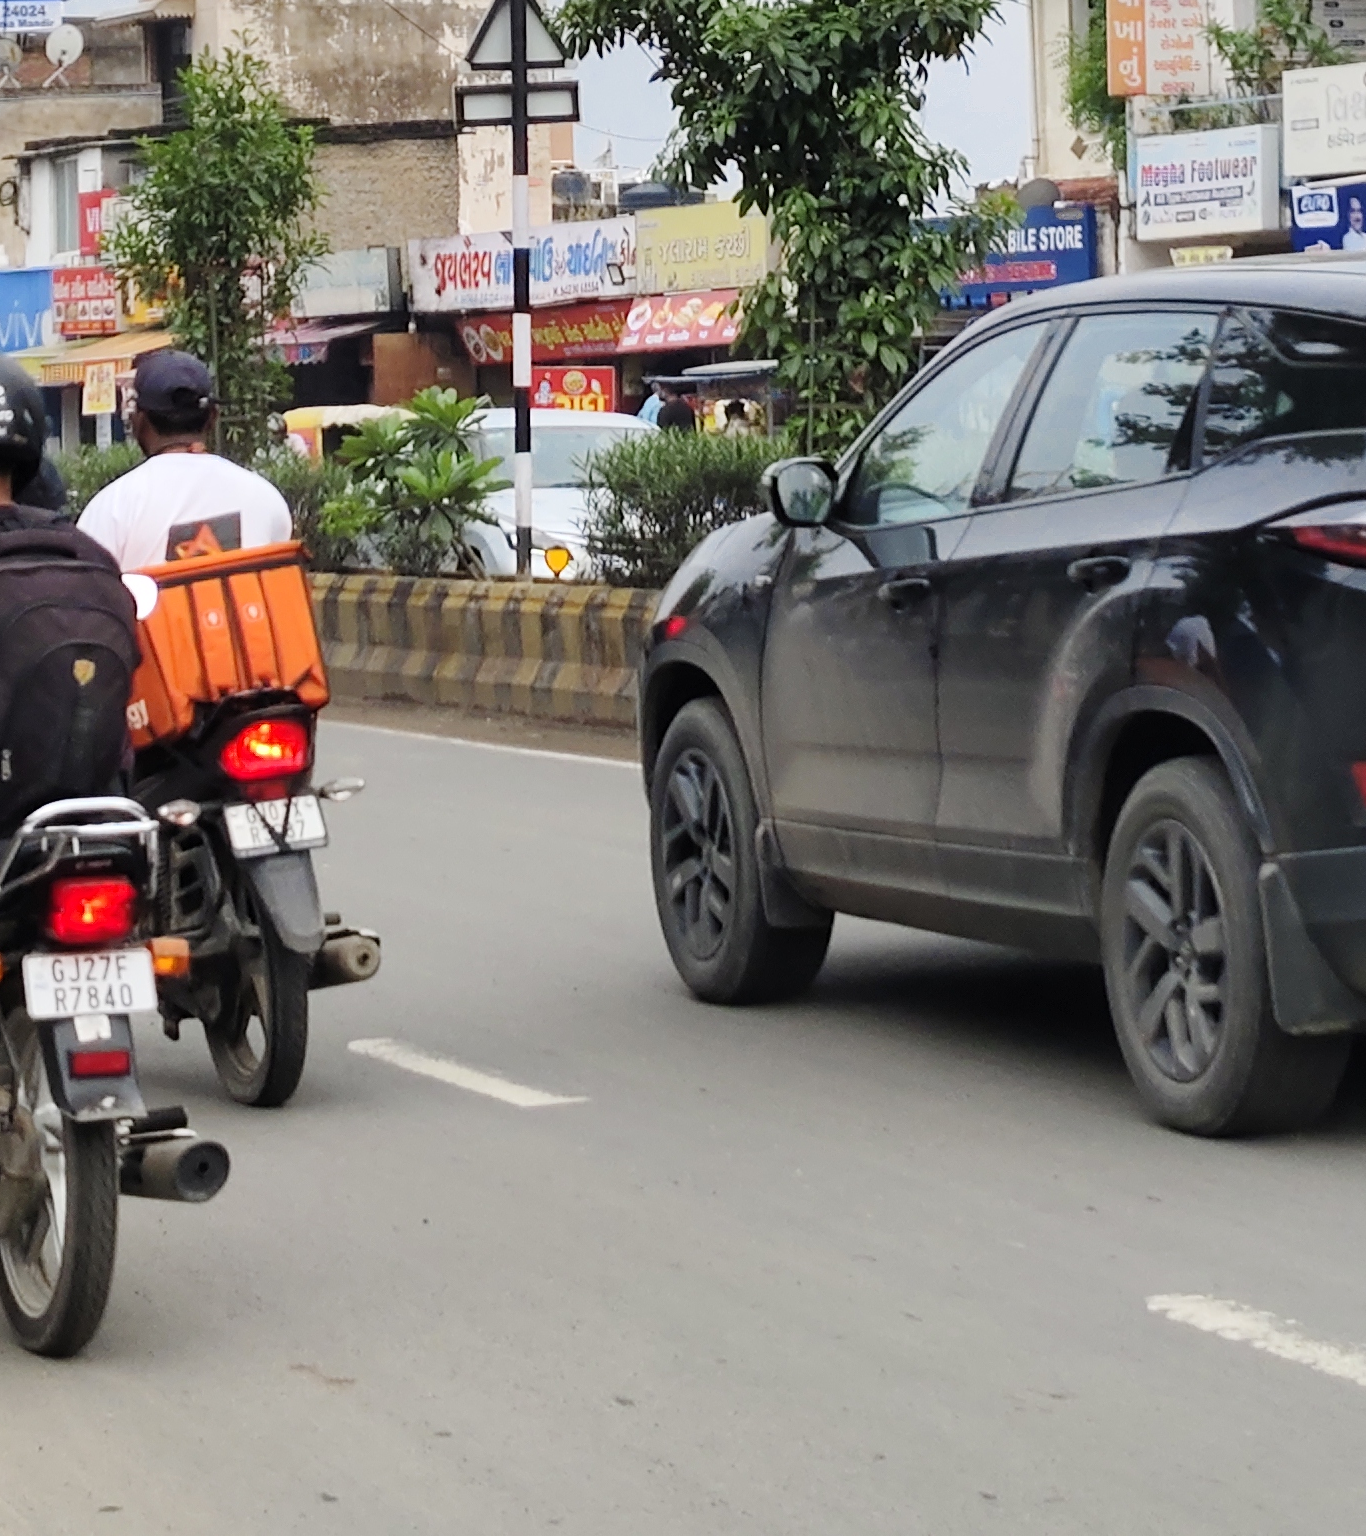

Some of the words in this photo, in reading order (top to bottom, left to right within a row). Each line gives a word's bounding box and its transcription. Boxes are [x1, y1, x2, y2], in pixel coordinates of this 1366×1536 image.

[1141, 162, 1186, 188] Megha
[1190, 155, 1258, 184] Footwear
[658, 233, 709, 266] જલારામ
[1038, 224, 1084, 251] STORE
[51, 955, 127, 983] GJ27F
[54, 984, 133, 1012] R7840
